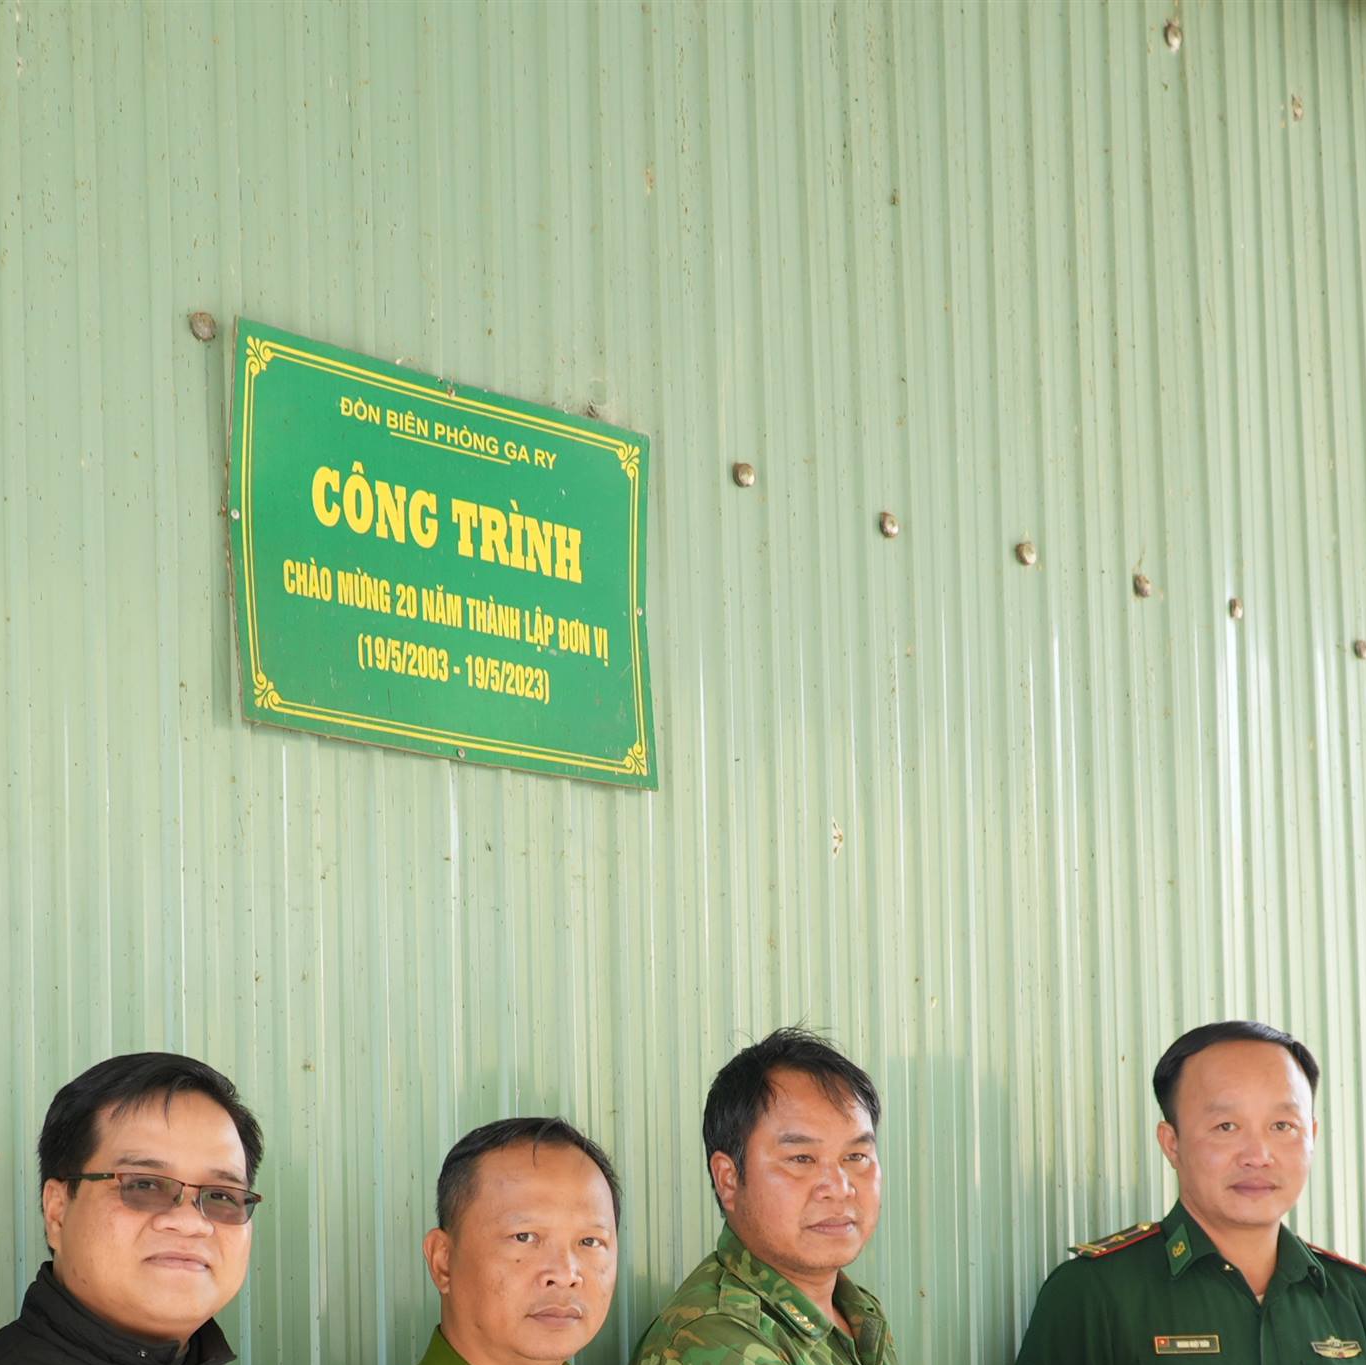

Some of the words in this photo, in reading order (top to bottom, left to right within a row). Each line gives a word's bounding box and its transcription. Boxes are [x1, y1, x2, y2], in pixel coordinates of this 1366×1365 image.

[386, 409, 429, 438] BIÊN
[434, 422, 499, 455] PHÒNG
[503, 441, 530, 464] GA
[534, 448, 557, 470] RY
[311, 460, 439, 549] CÔNG
[451, 498, 582, 584] TRÌNH
[283, 557, 333, 602] CHÀO
[337, 567, 391, 614] MỪNG
[395, 583, 418, 619] 20
[421, 584, 463, 628] NĂM
[466, 595, 521, 641] THÀNH
[524, 605, 555, 653] LẬP
[558, 617, 591, 656] ĐƠN
[593, 626, 609, 667] VỊ
[357, 633, 449, 683] (19/5/2003
[465, 654, 550, 705] 19/5/2023)
